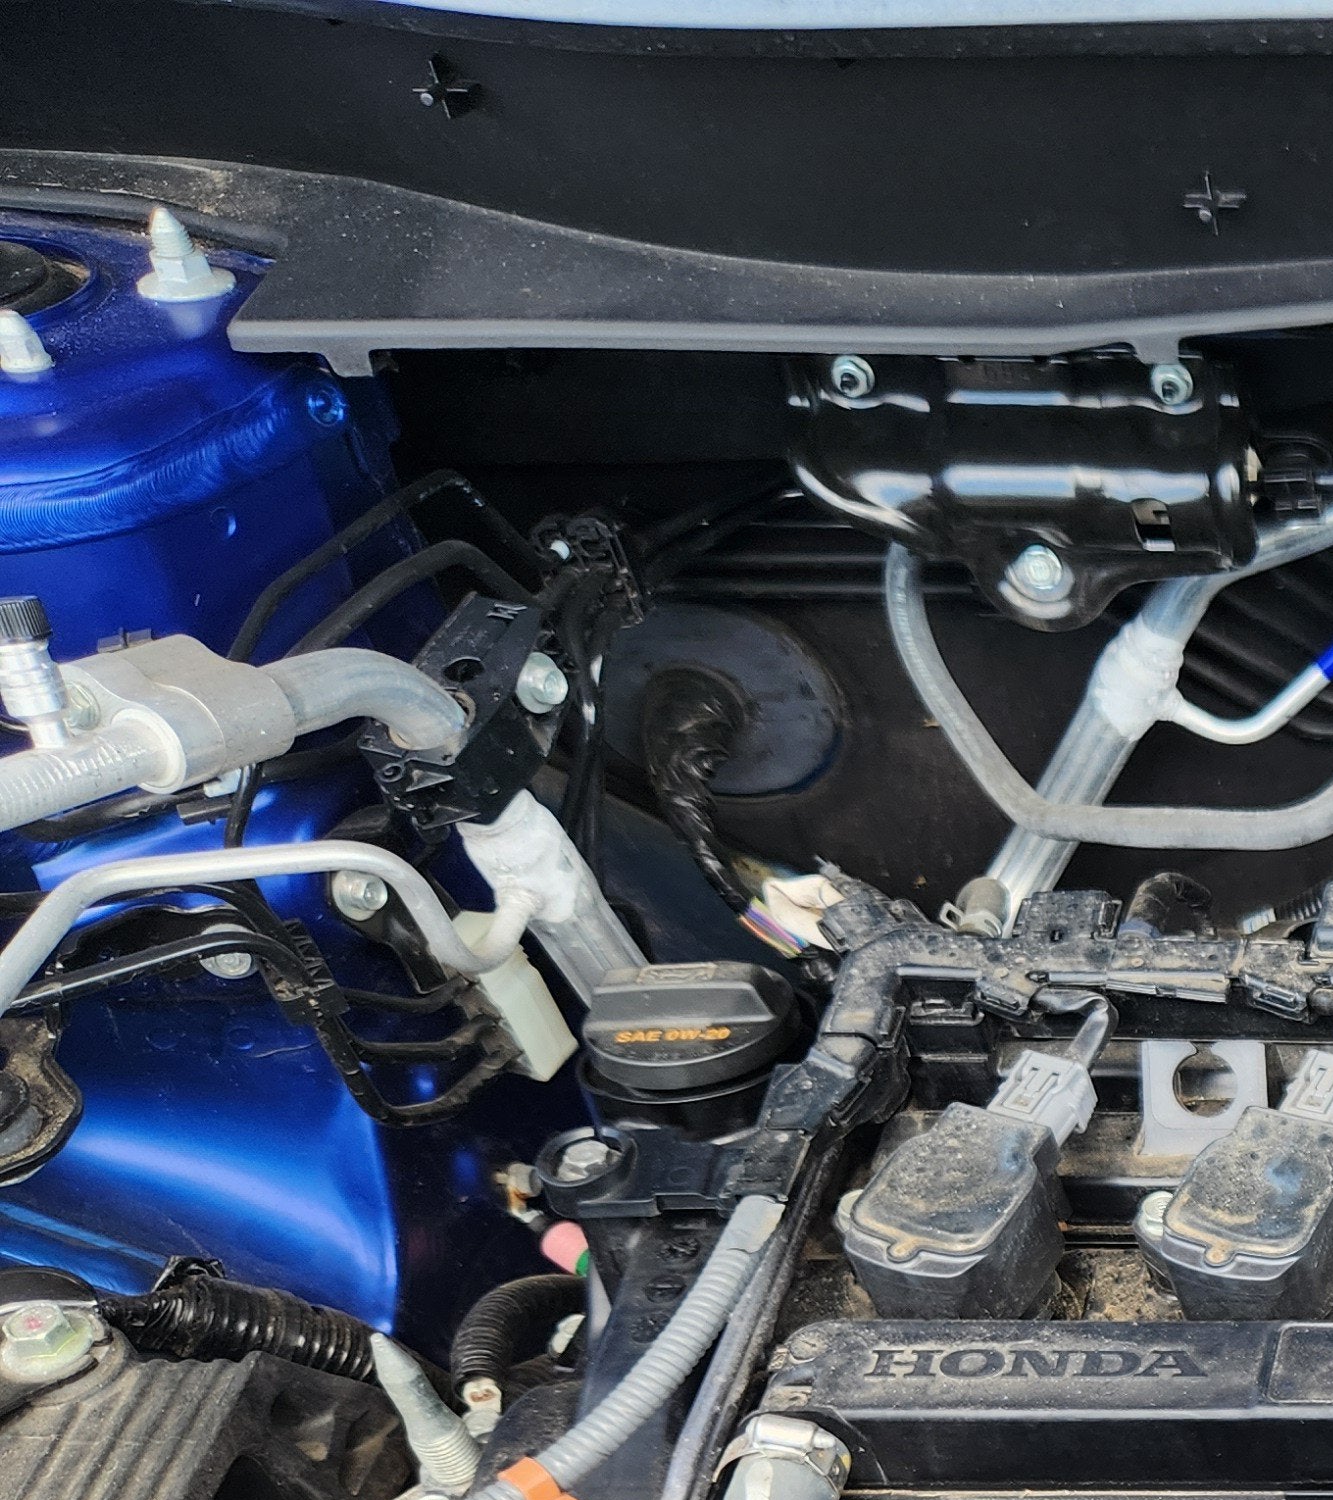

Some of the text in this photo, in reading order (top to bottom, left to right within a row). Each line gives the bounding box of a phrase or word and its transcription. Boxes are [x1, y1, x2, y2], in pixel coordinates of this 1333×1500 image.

[615, 1026, 732, 1044] SAE 0W-20
[863, 1348, 1208, 1378] HONDA
